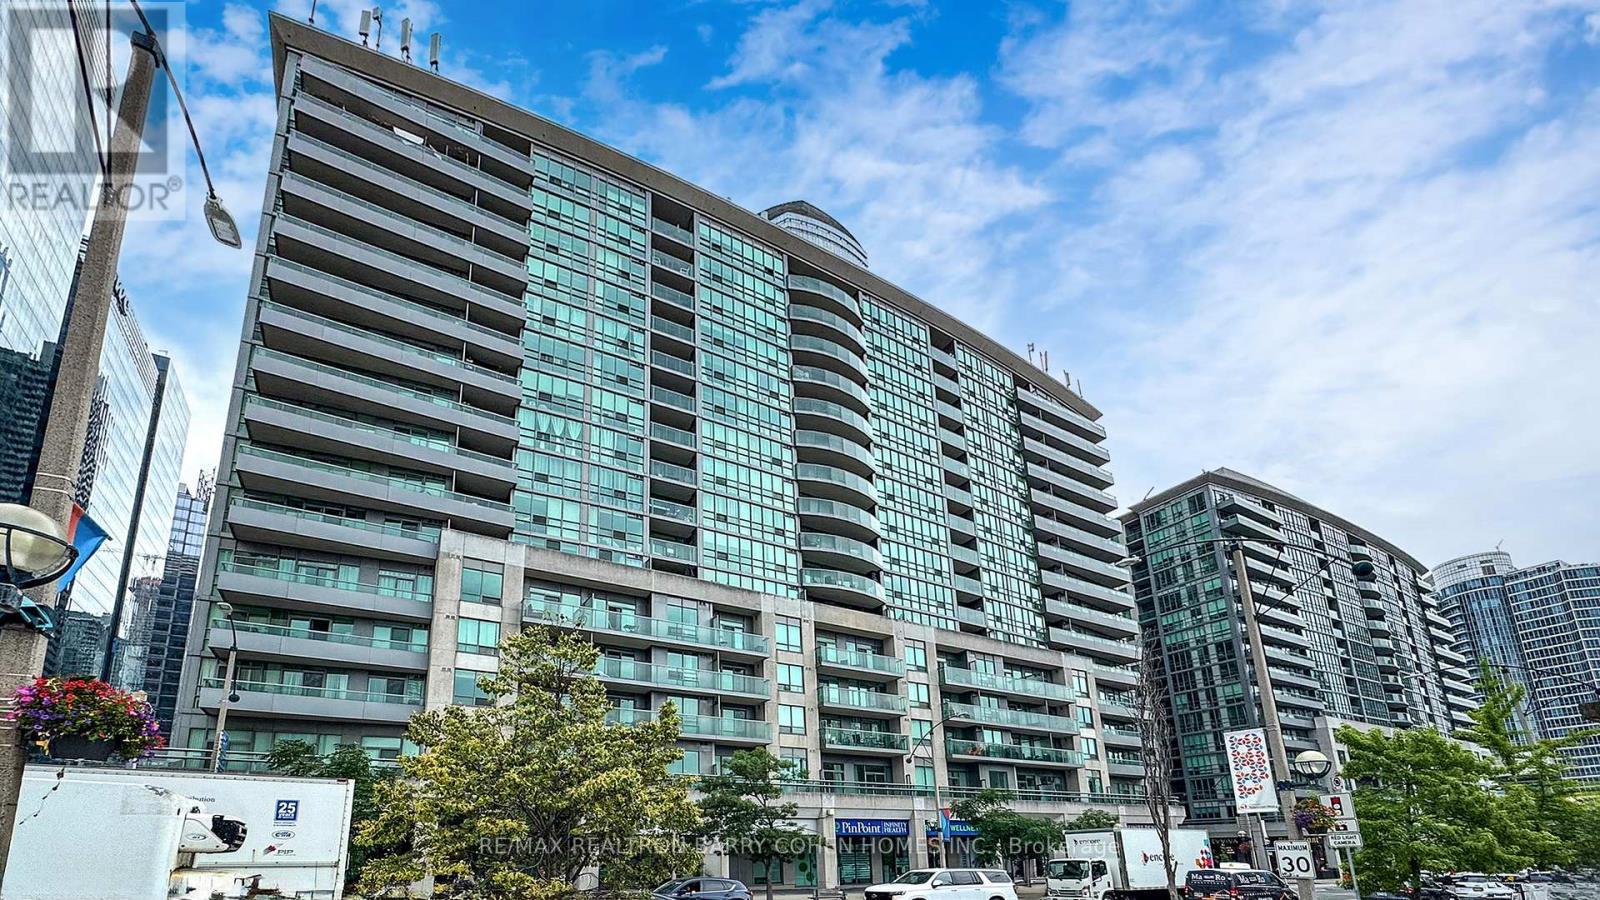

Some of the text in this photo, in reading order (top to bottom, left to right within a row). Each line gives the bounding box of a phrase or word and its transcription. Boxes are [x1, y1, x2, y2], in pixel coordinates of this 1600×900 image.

[278, 802, 297, 814] 25
[842, 821, 881, 833] PinPoint
[1282, 856, 1310, 872] 30
